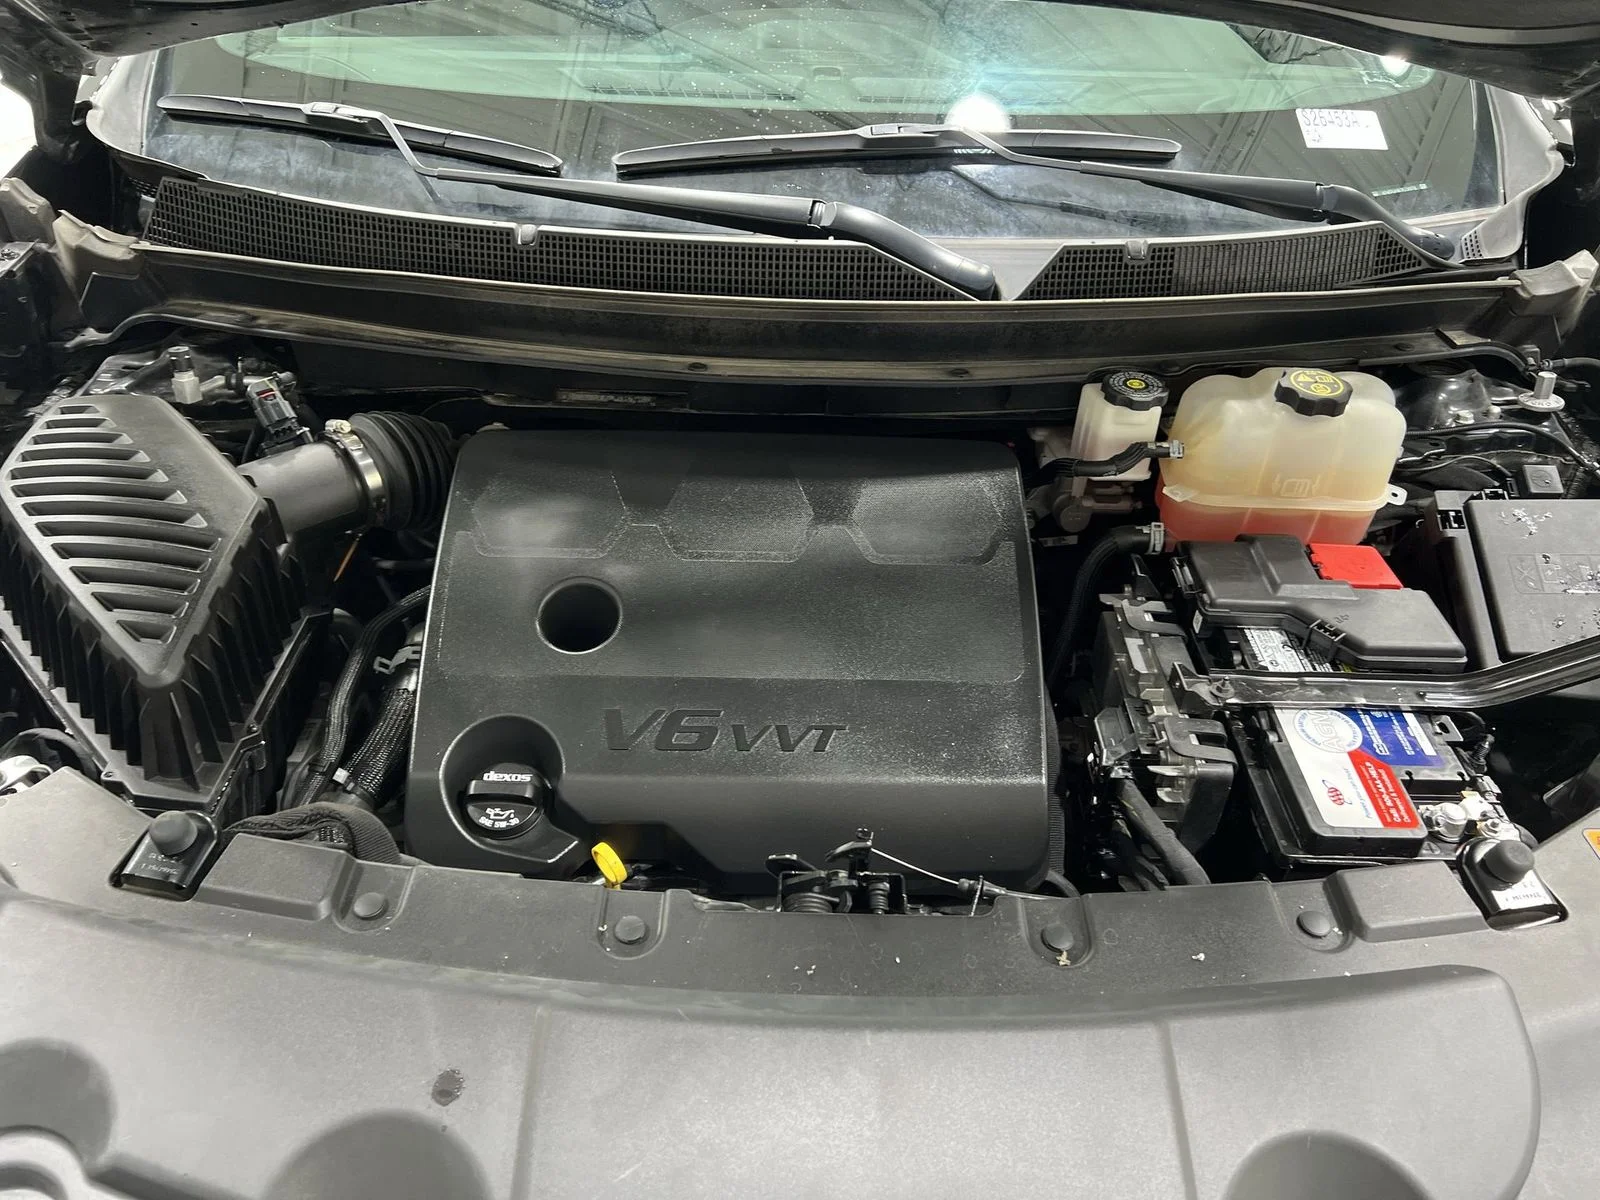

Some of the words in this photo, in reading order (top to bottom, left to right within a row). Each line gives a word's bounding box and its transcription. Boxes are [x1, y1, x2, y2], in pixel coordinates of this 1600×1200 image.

[603, 708, 724, 751] V6
[731, 724, 848, 752] VVT
[483, 771, 533, 782] dexos
[479, 816, 494, 827] SAE
[494, 817, 520, 828] 5W-30
